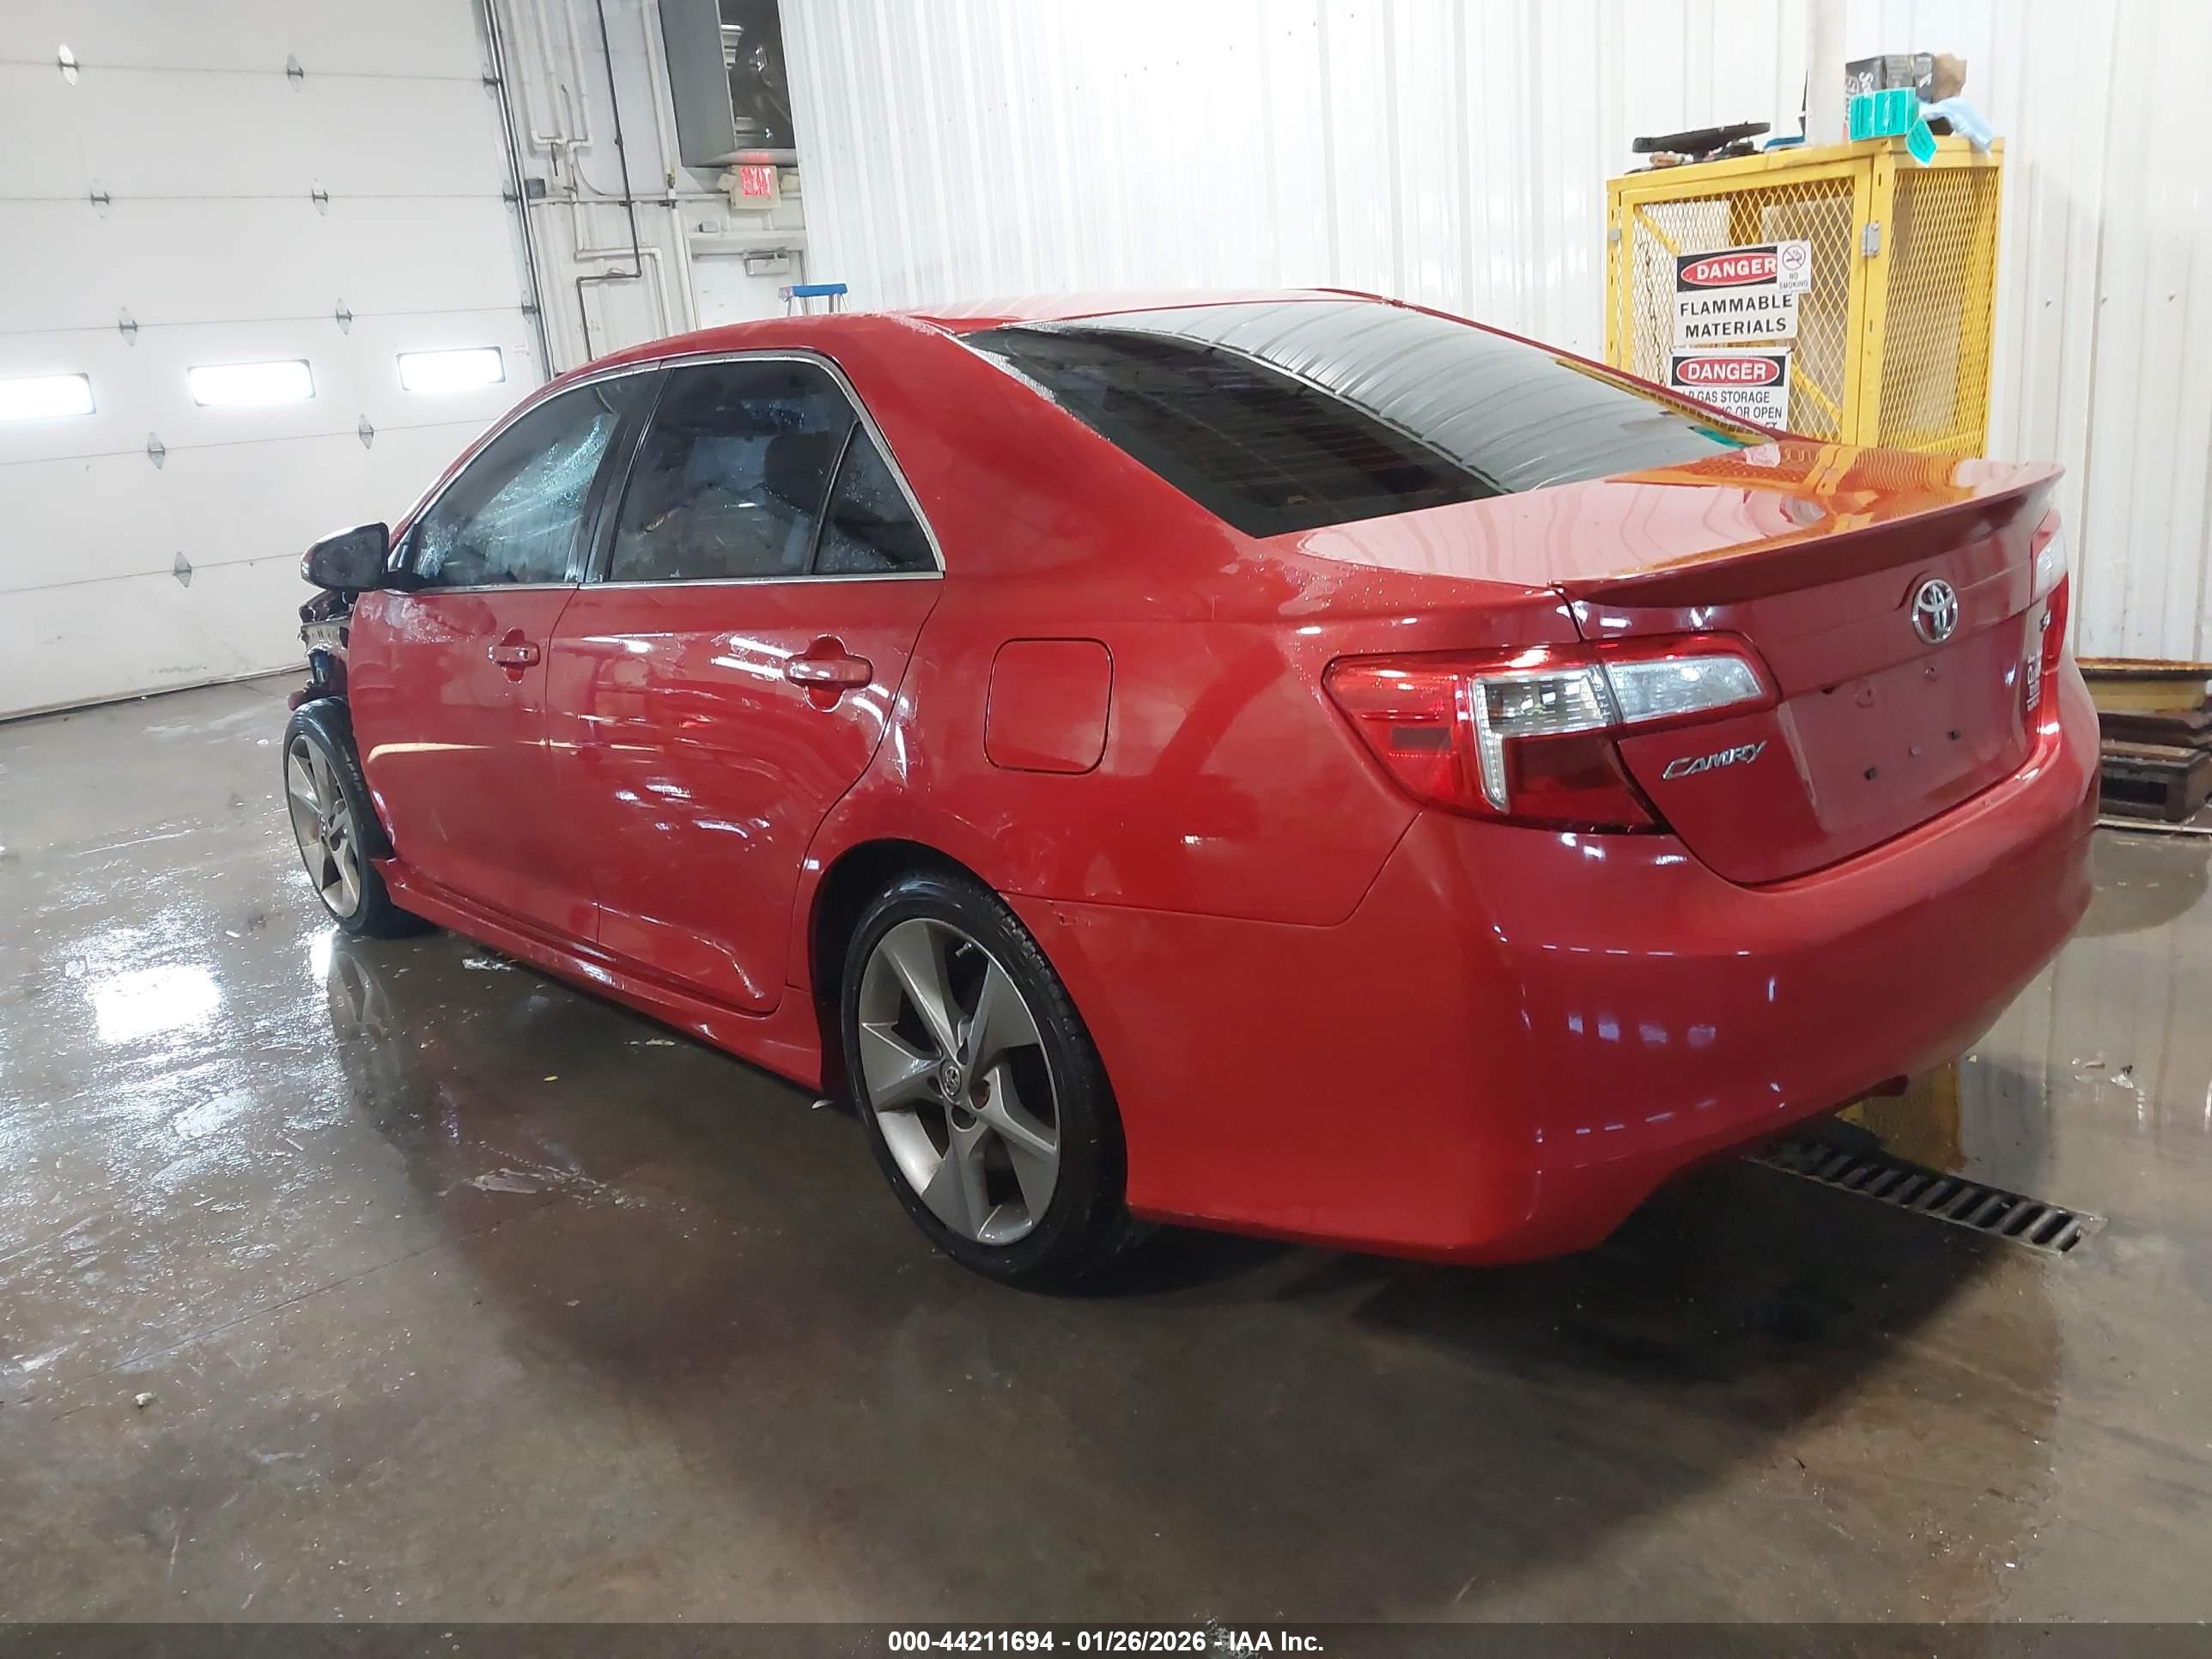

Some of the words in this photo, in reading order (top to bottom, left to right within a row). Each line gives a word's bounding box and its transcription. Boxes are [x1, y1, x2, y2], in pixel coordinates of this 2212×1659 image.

[741, 166, 772, 197] EXIT
[1696, 257, 1777, 281] DANGER
[1788, 271, 1799, 280] NO
[1778, 280, 1808, 290] SMOKING
[1680, 294, 1793, 317] FLAMMABLE
[1685, 317, 1787, 339] MATERIALS
[1687, 362, 1767, 380] DANGER
[1697, 391, 1718, 404] GAS
[1720, 391, 1771, 404] STORAGE
[1735, 406, 1750, 419] OR
[1753, 406, 1783, 419] OPEN
[1662, 740, 1768, 781] CAMRY
